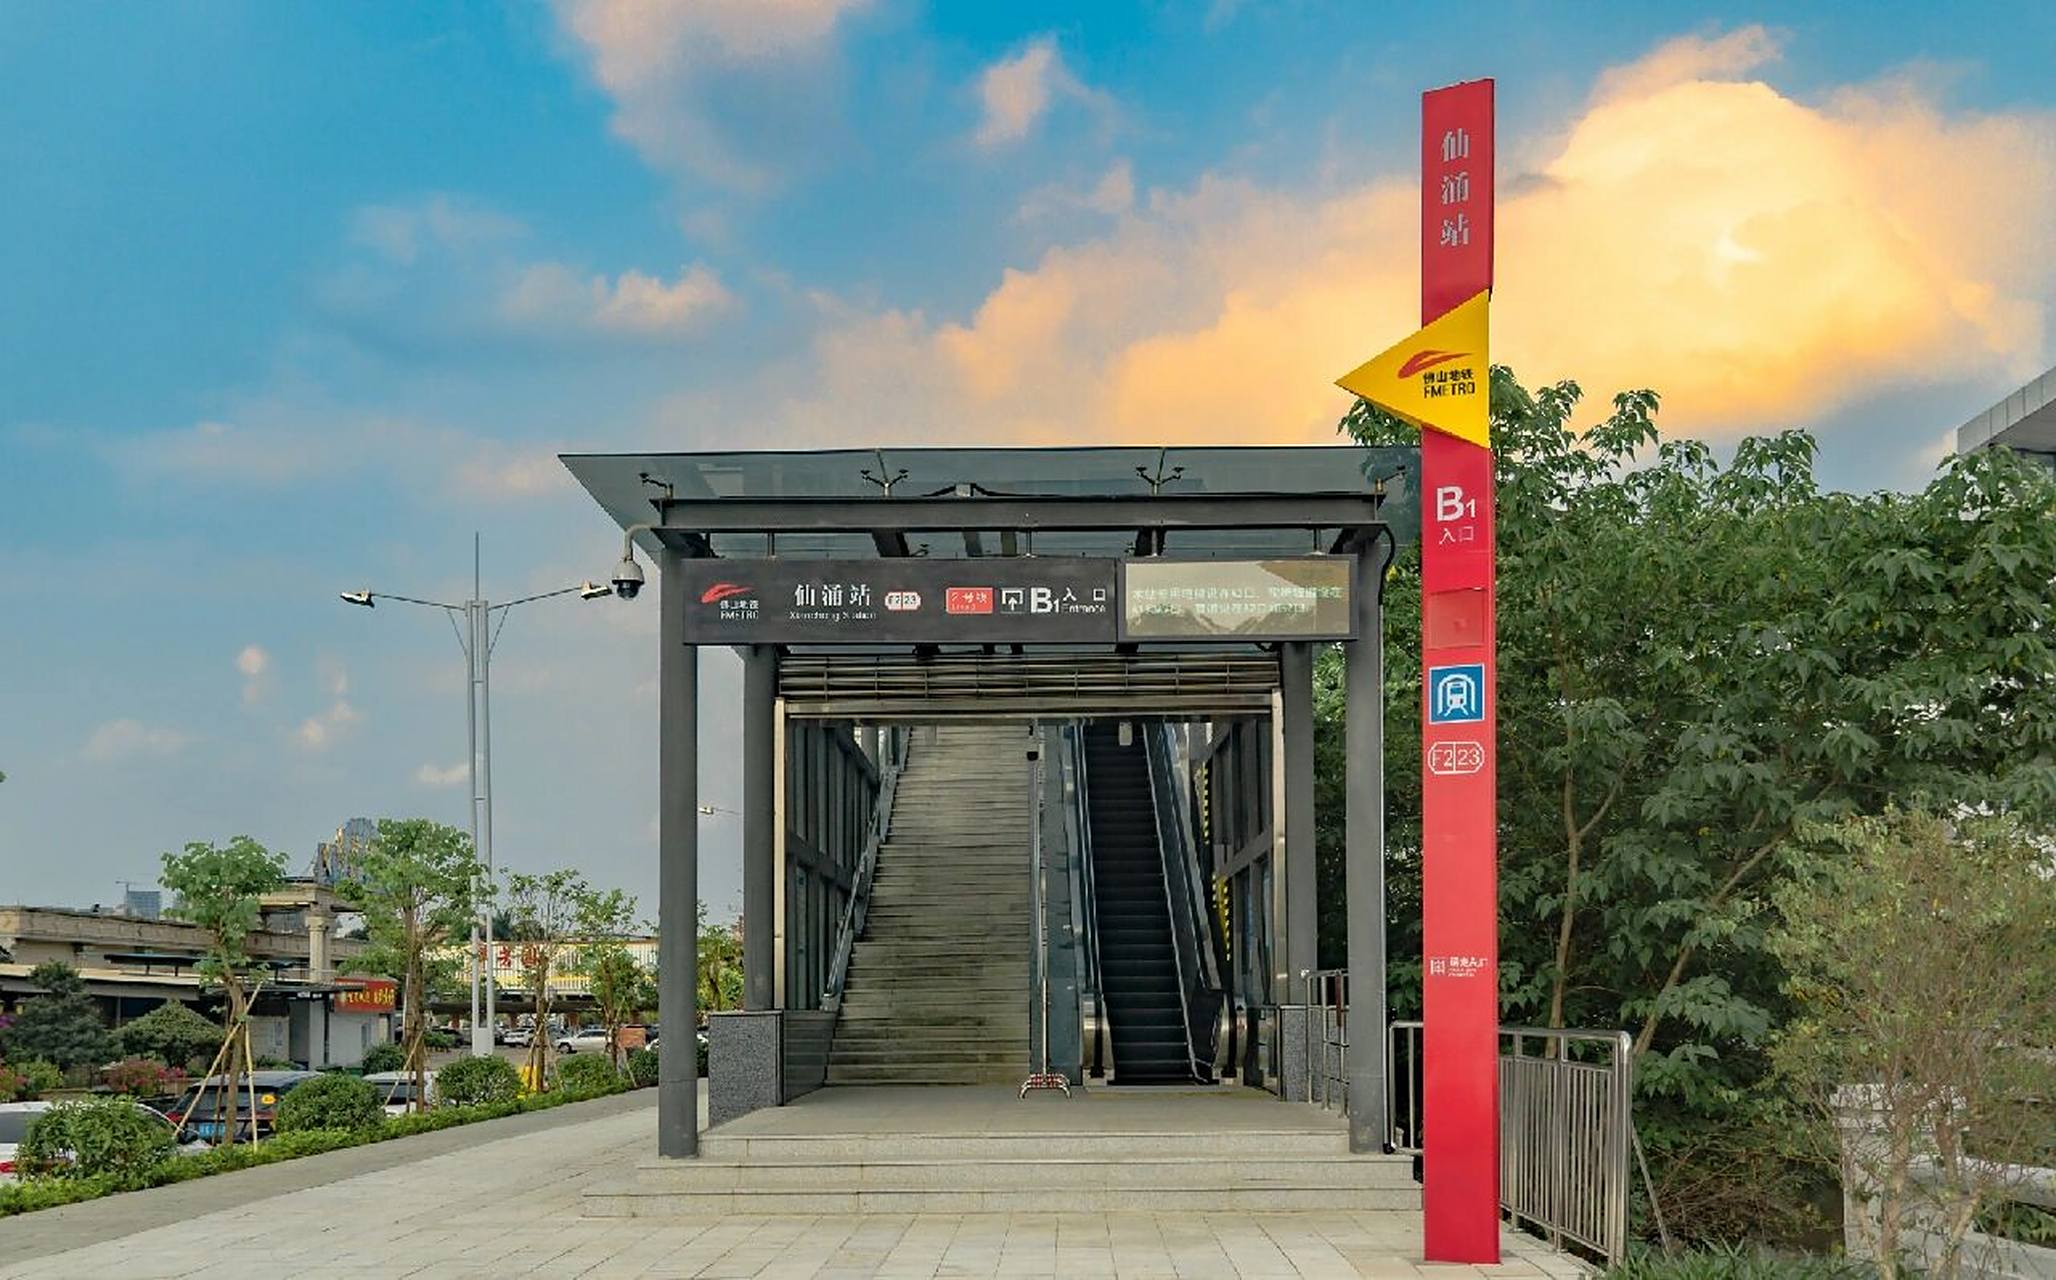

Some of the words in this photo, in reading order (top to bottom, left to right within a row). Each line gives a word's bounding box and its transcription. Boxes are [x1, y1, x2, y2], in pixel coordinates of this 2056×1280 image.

[1423, 368, 1473, 385] 佛山地铁
[1423, 381, 1476, 399] FMETRO
[1436, 485, 1476, 523] B1
[1438, 525, 1475, 545] 入口
[1030, 586, 1060, 613] B1
[1062, 586, 1107, 602] 入口
[719, 609, 759, 621] FMETRO
[1062, 603, 1107, 614] Entrance
[1432, 748, 1453, 768] F2
[1456, 748, 1481, 767] 23
